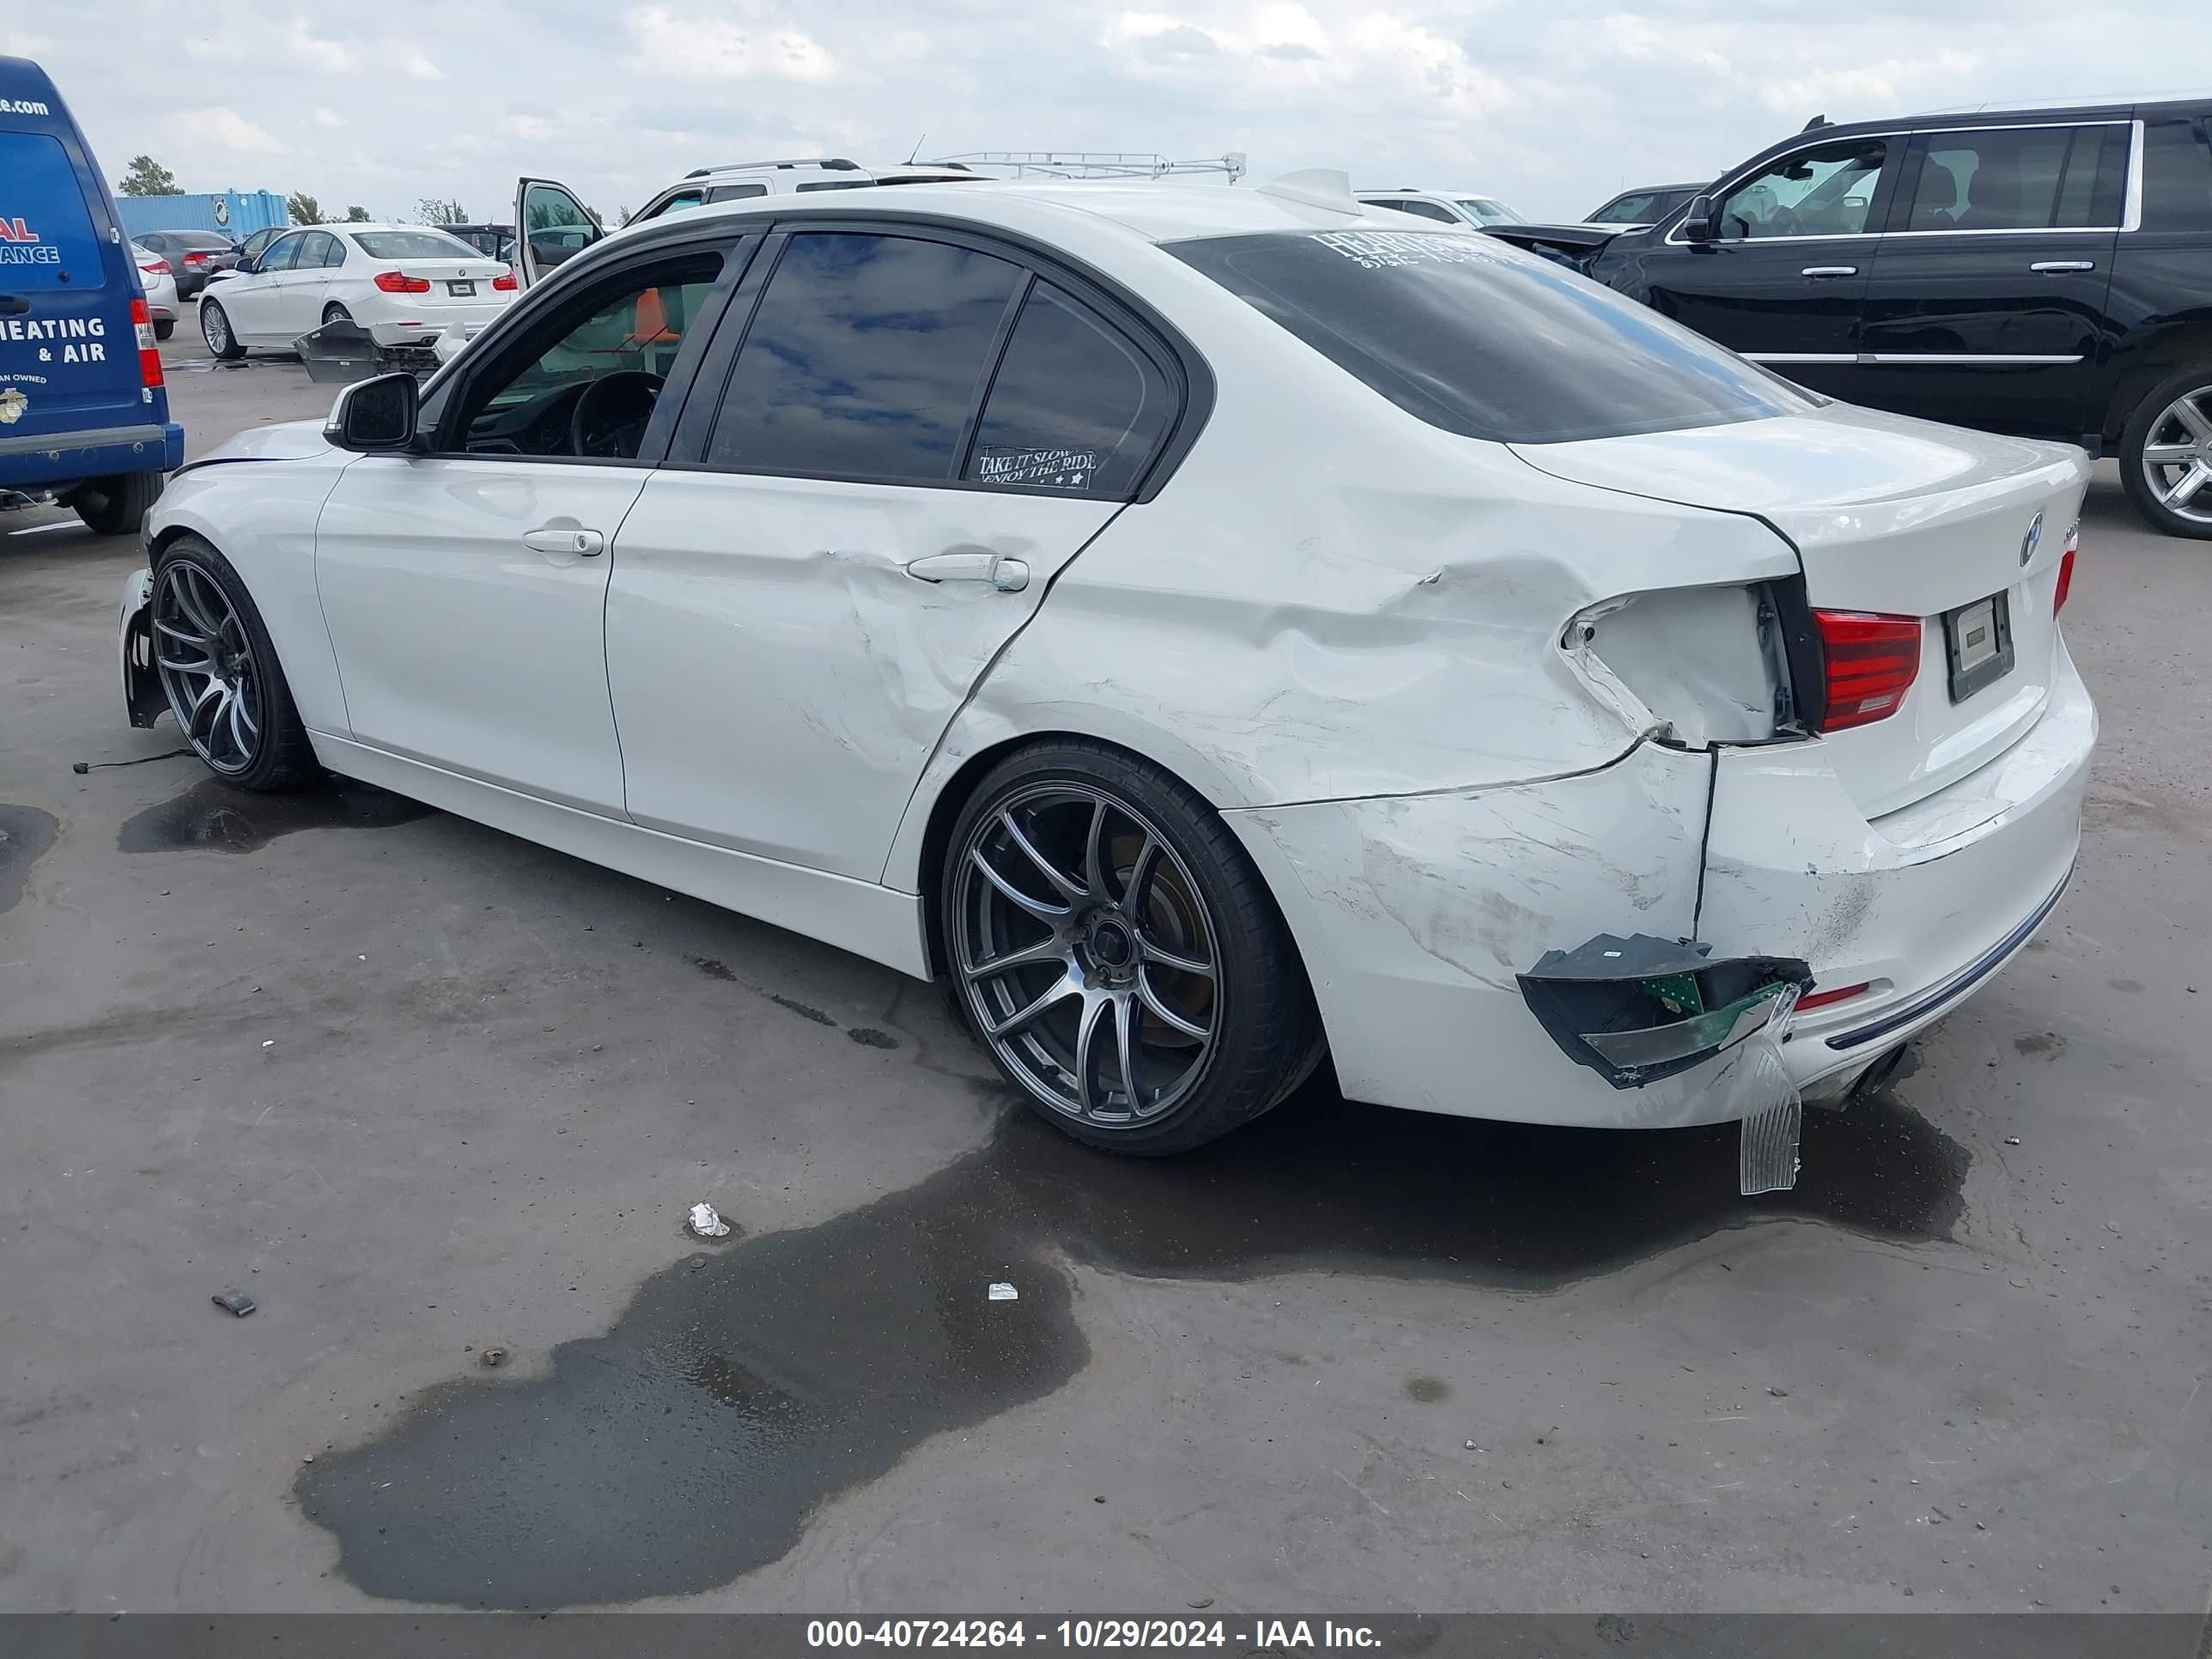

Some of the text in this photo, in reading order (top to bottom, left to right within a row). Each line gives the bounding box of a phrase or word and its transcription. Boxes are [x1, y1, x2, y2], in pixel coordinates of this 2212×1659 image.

[0, 99, 50, 116] e.com
[39, 343, 106, 363] & AIR
[12, 374, 48, 385] OWNED
[980, 457, 1013, 474] TAKE
[1033, 450, 1072, 464] SLOW
[983, 454, 1097, 483] ENJOY THE RIDE
